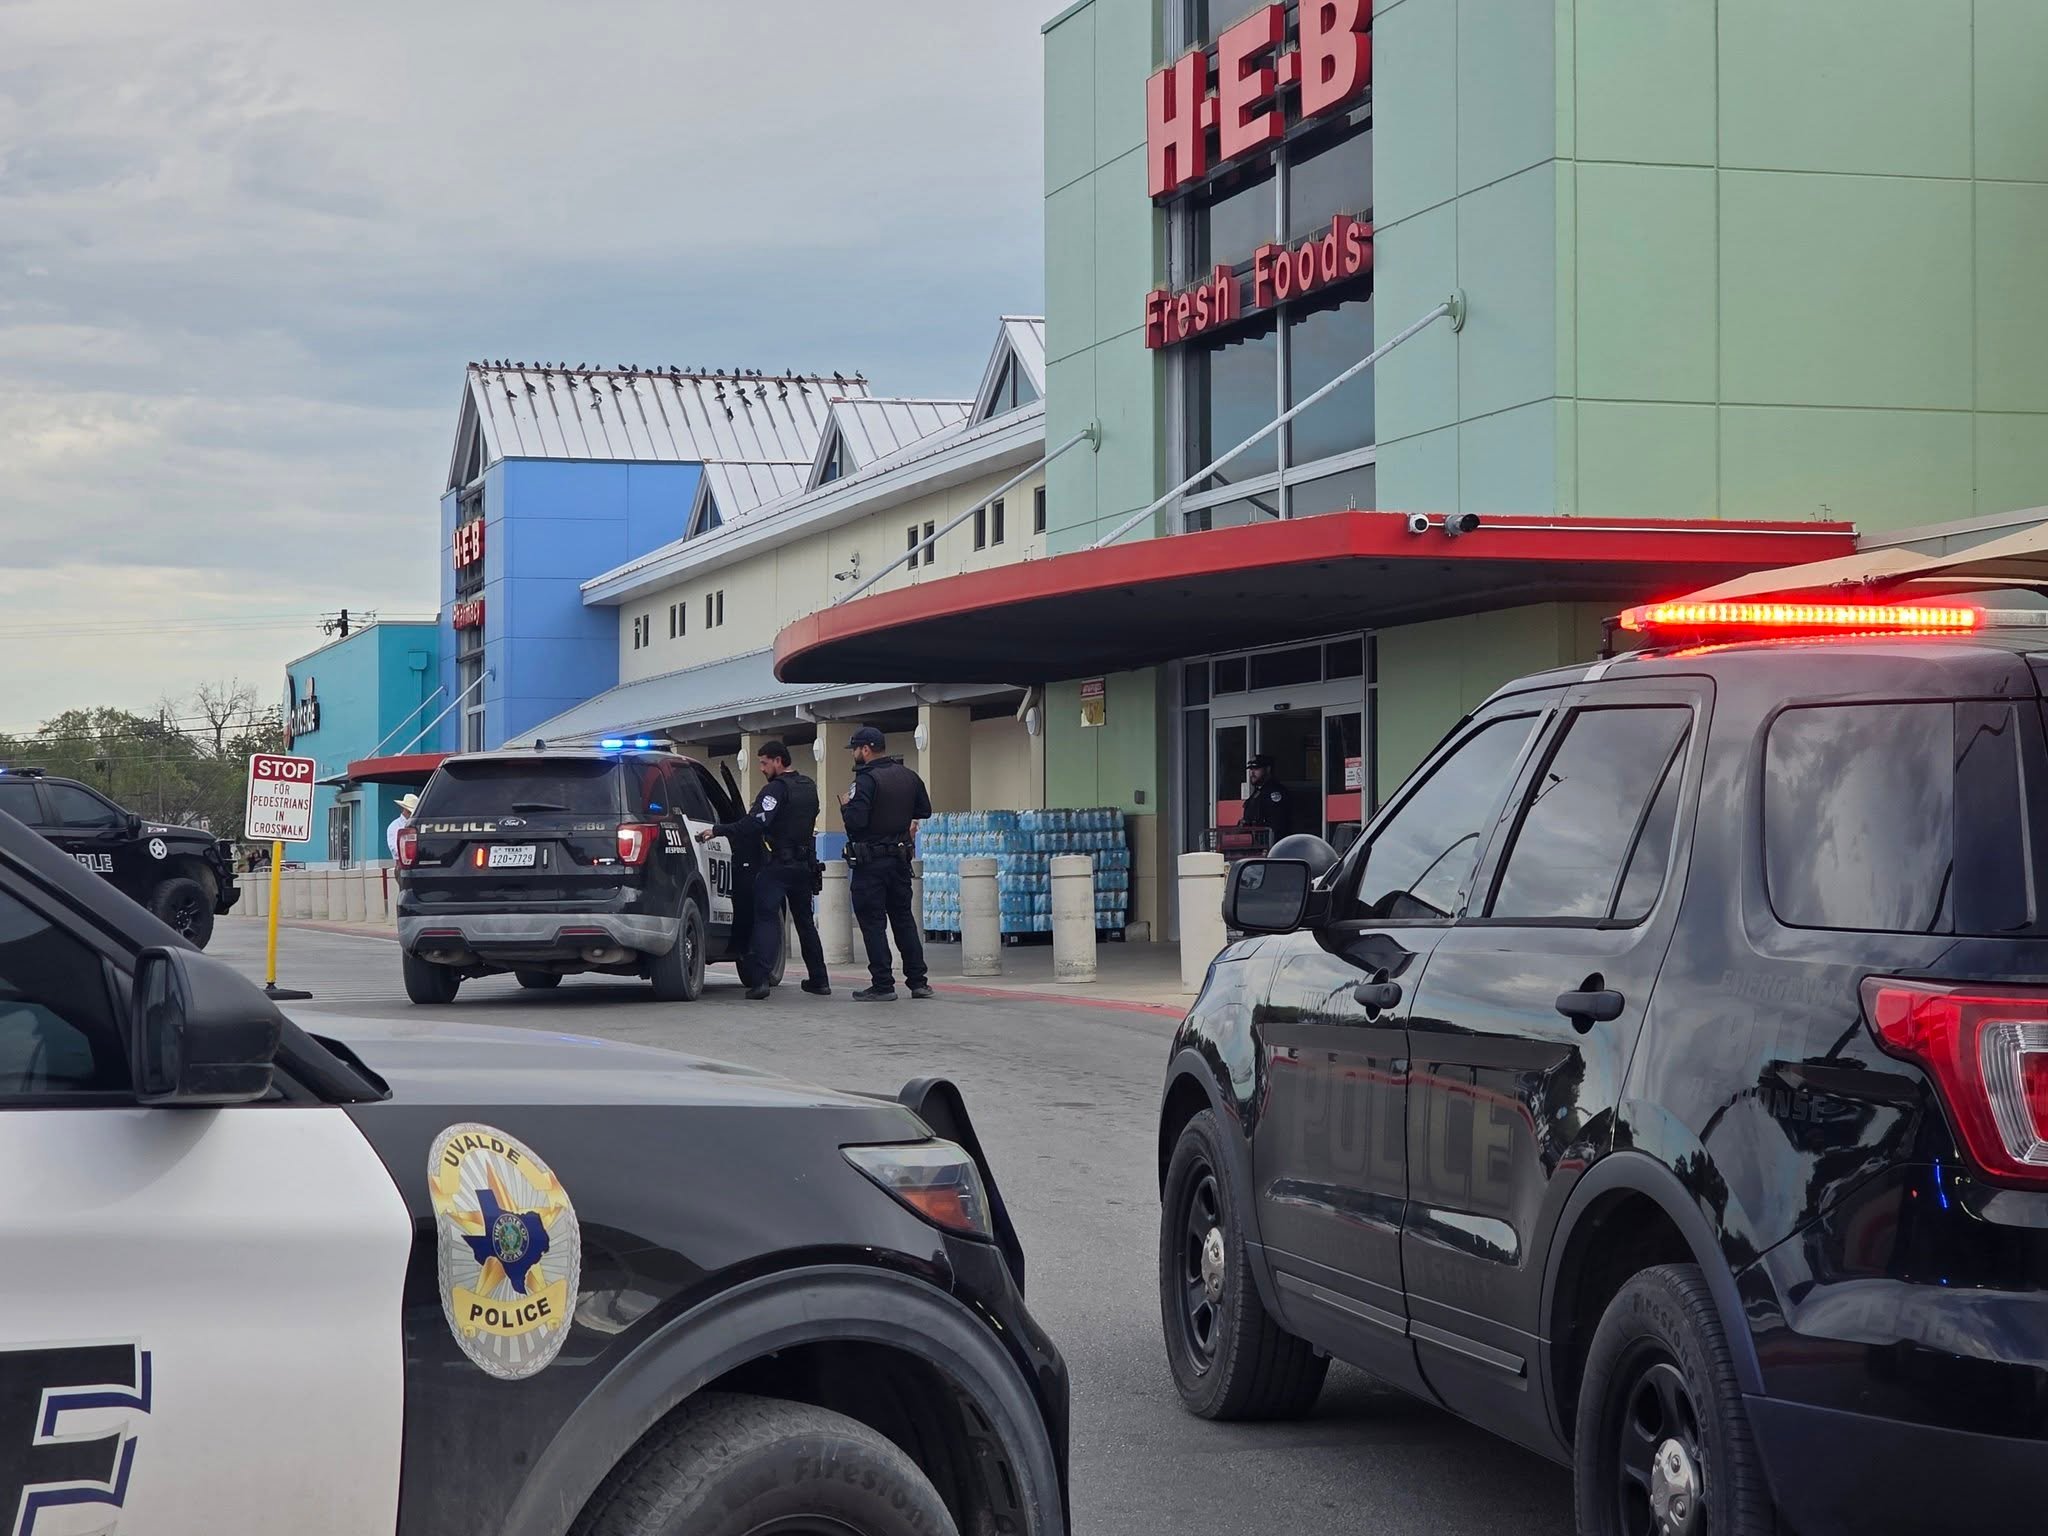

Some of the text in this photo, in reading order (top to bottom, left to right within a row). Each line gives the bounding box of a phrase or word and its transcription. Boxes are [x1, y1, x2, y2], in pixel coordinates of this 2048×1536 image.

[1146, 216, 1370, 348] Fresh Foods
[258, 760, 309, 778] STOP
[273, 783, 290, 795] FOR
[253, 796, 309, 810] PEDESTRIANS
[275, 811, 285, 821] IN
[254, 822, 304, 836] CROSSWALK
[420, 822, 496, 833] POLICE
[665, 830, 682, 846] 911
[444, 1135, 521, 1168] UVALDE
[470, 1297, 551, 1328] POLICE
